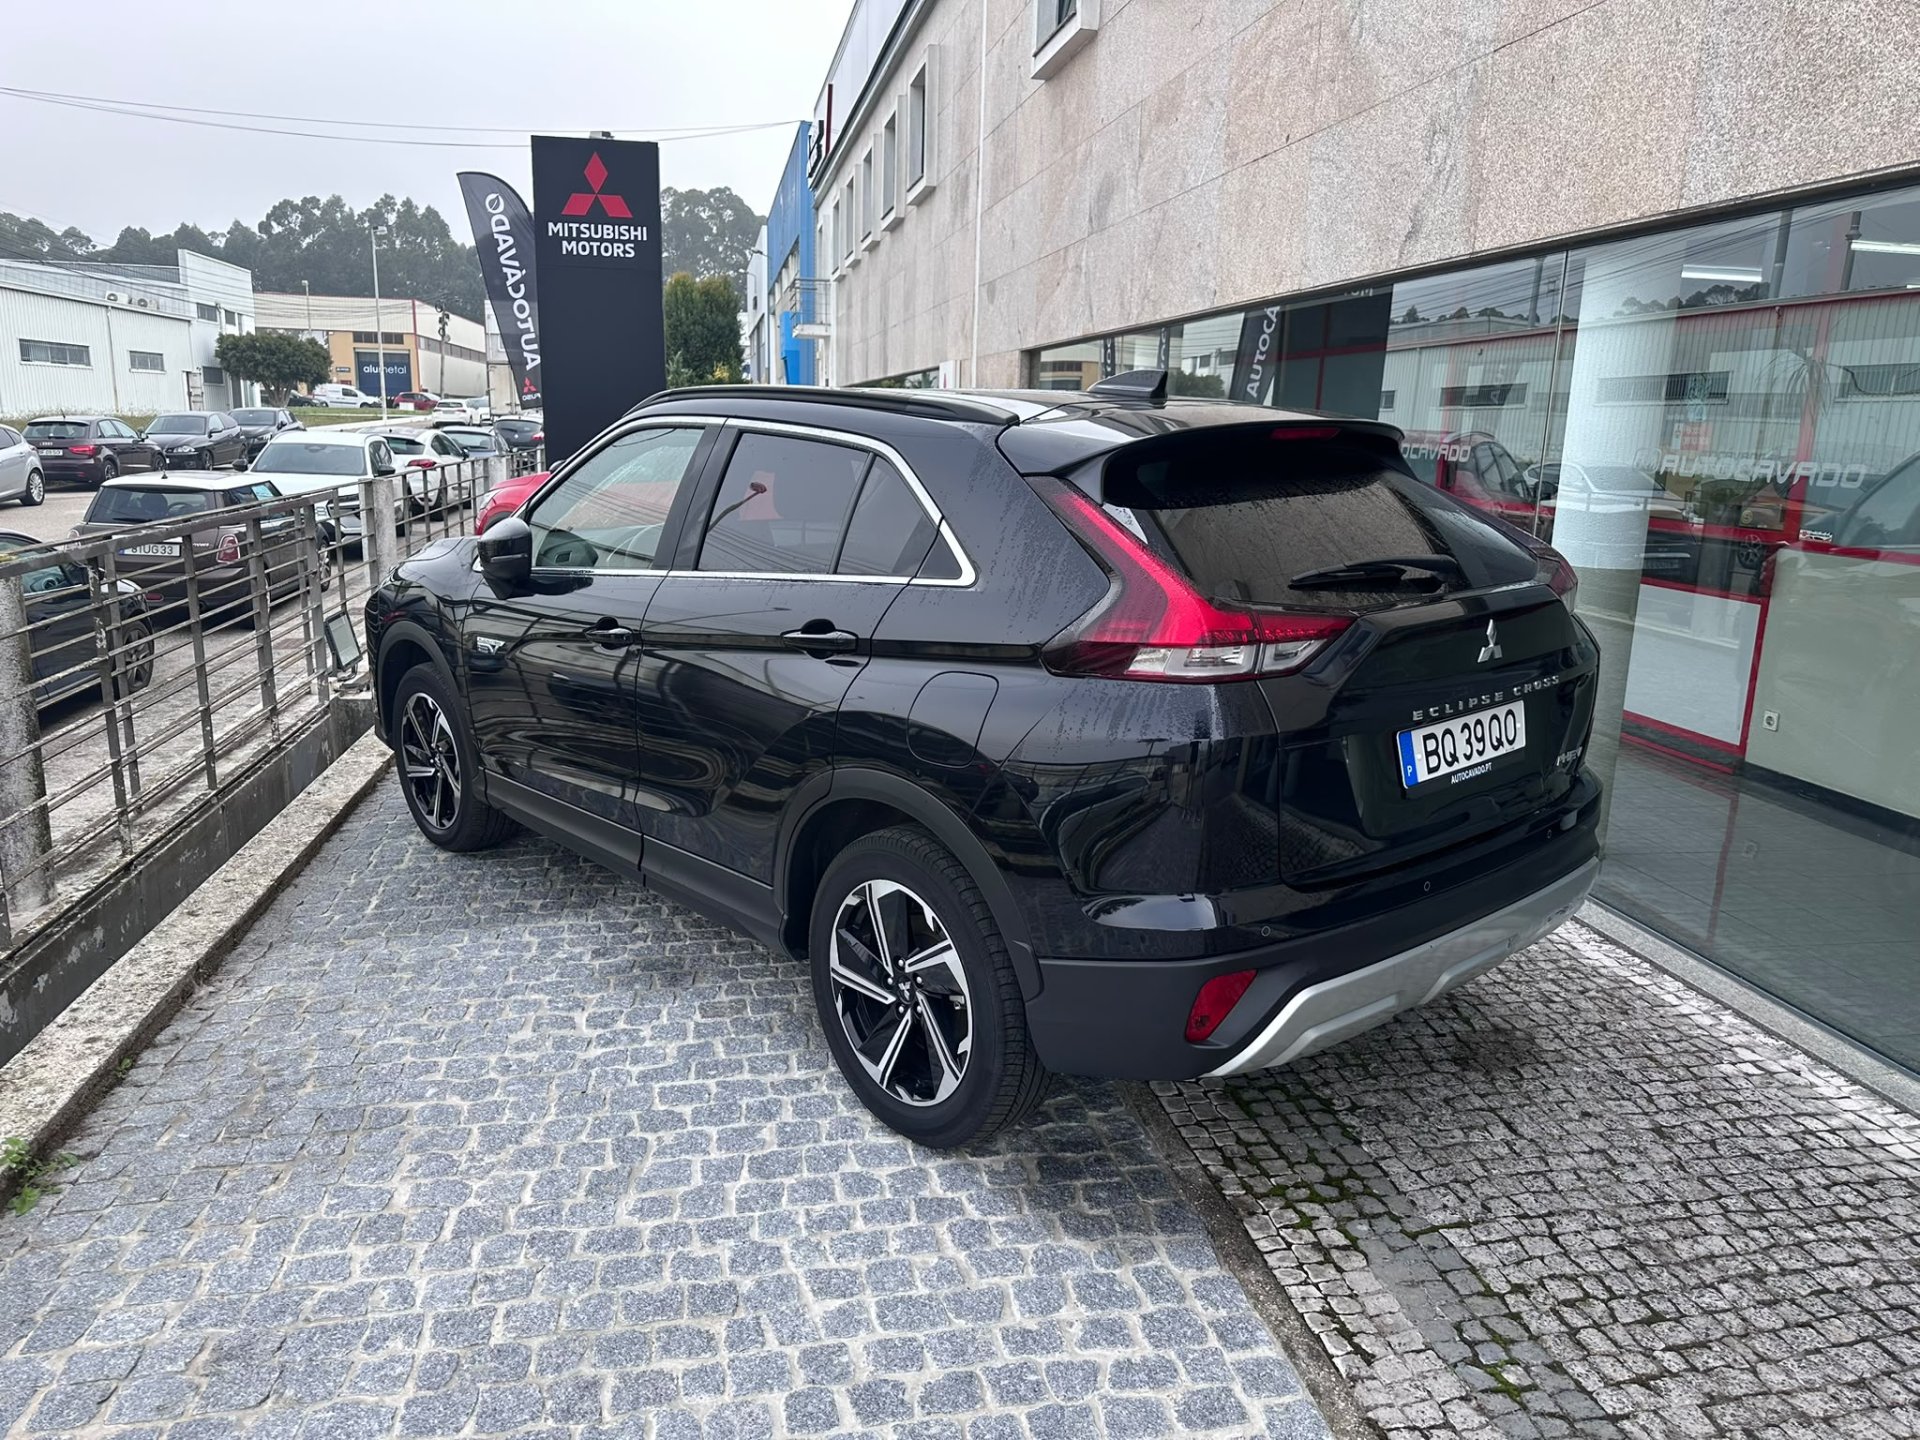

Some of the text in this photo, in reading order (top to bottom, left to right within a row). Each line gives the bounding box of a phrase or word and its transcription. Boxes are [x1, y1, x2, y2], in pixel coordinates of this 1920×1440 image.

[547, 221, 648, 241] MITSUBISHI
[561, 240, 635, 258] MOTORS
[1412, 675, 1560, 721] ECLIPSE CROSS
[1407, 765, 1413, 777] P
